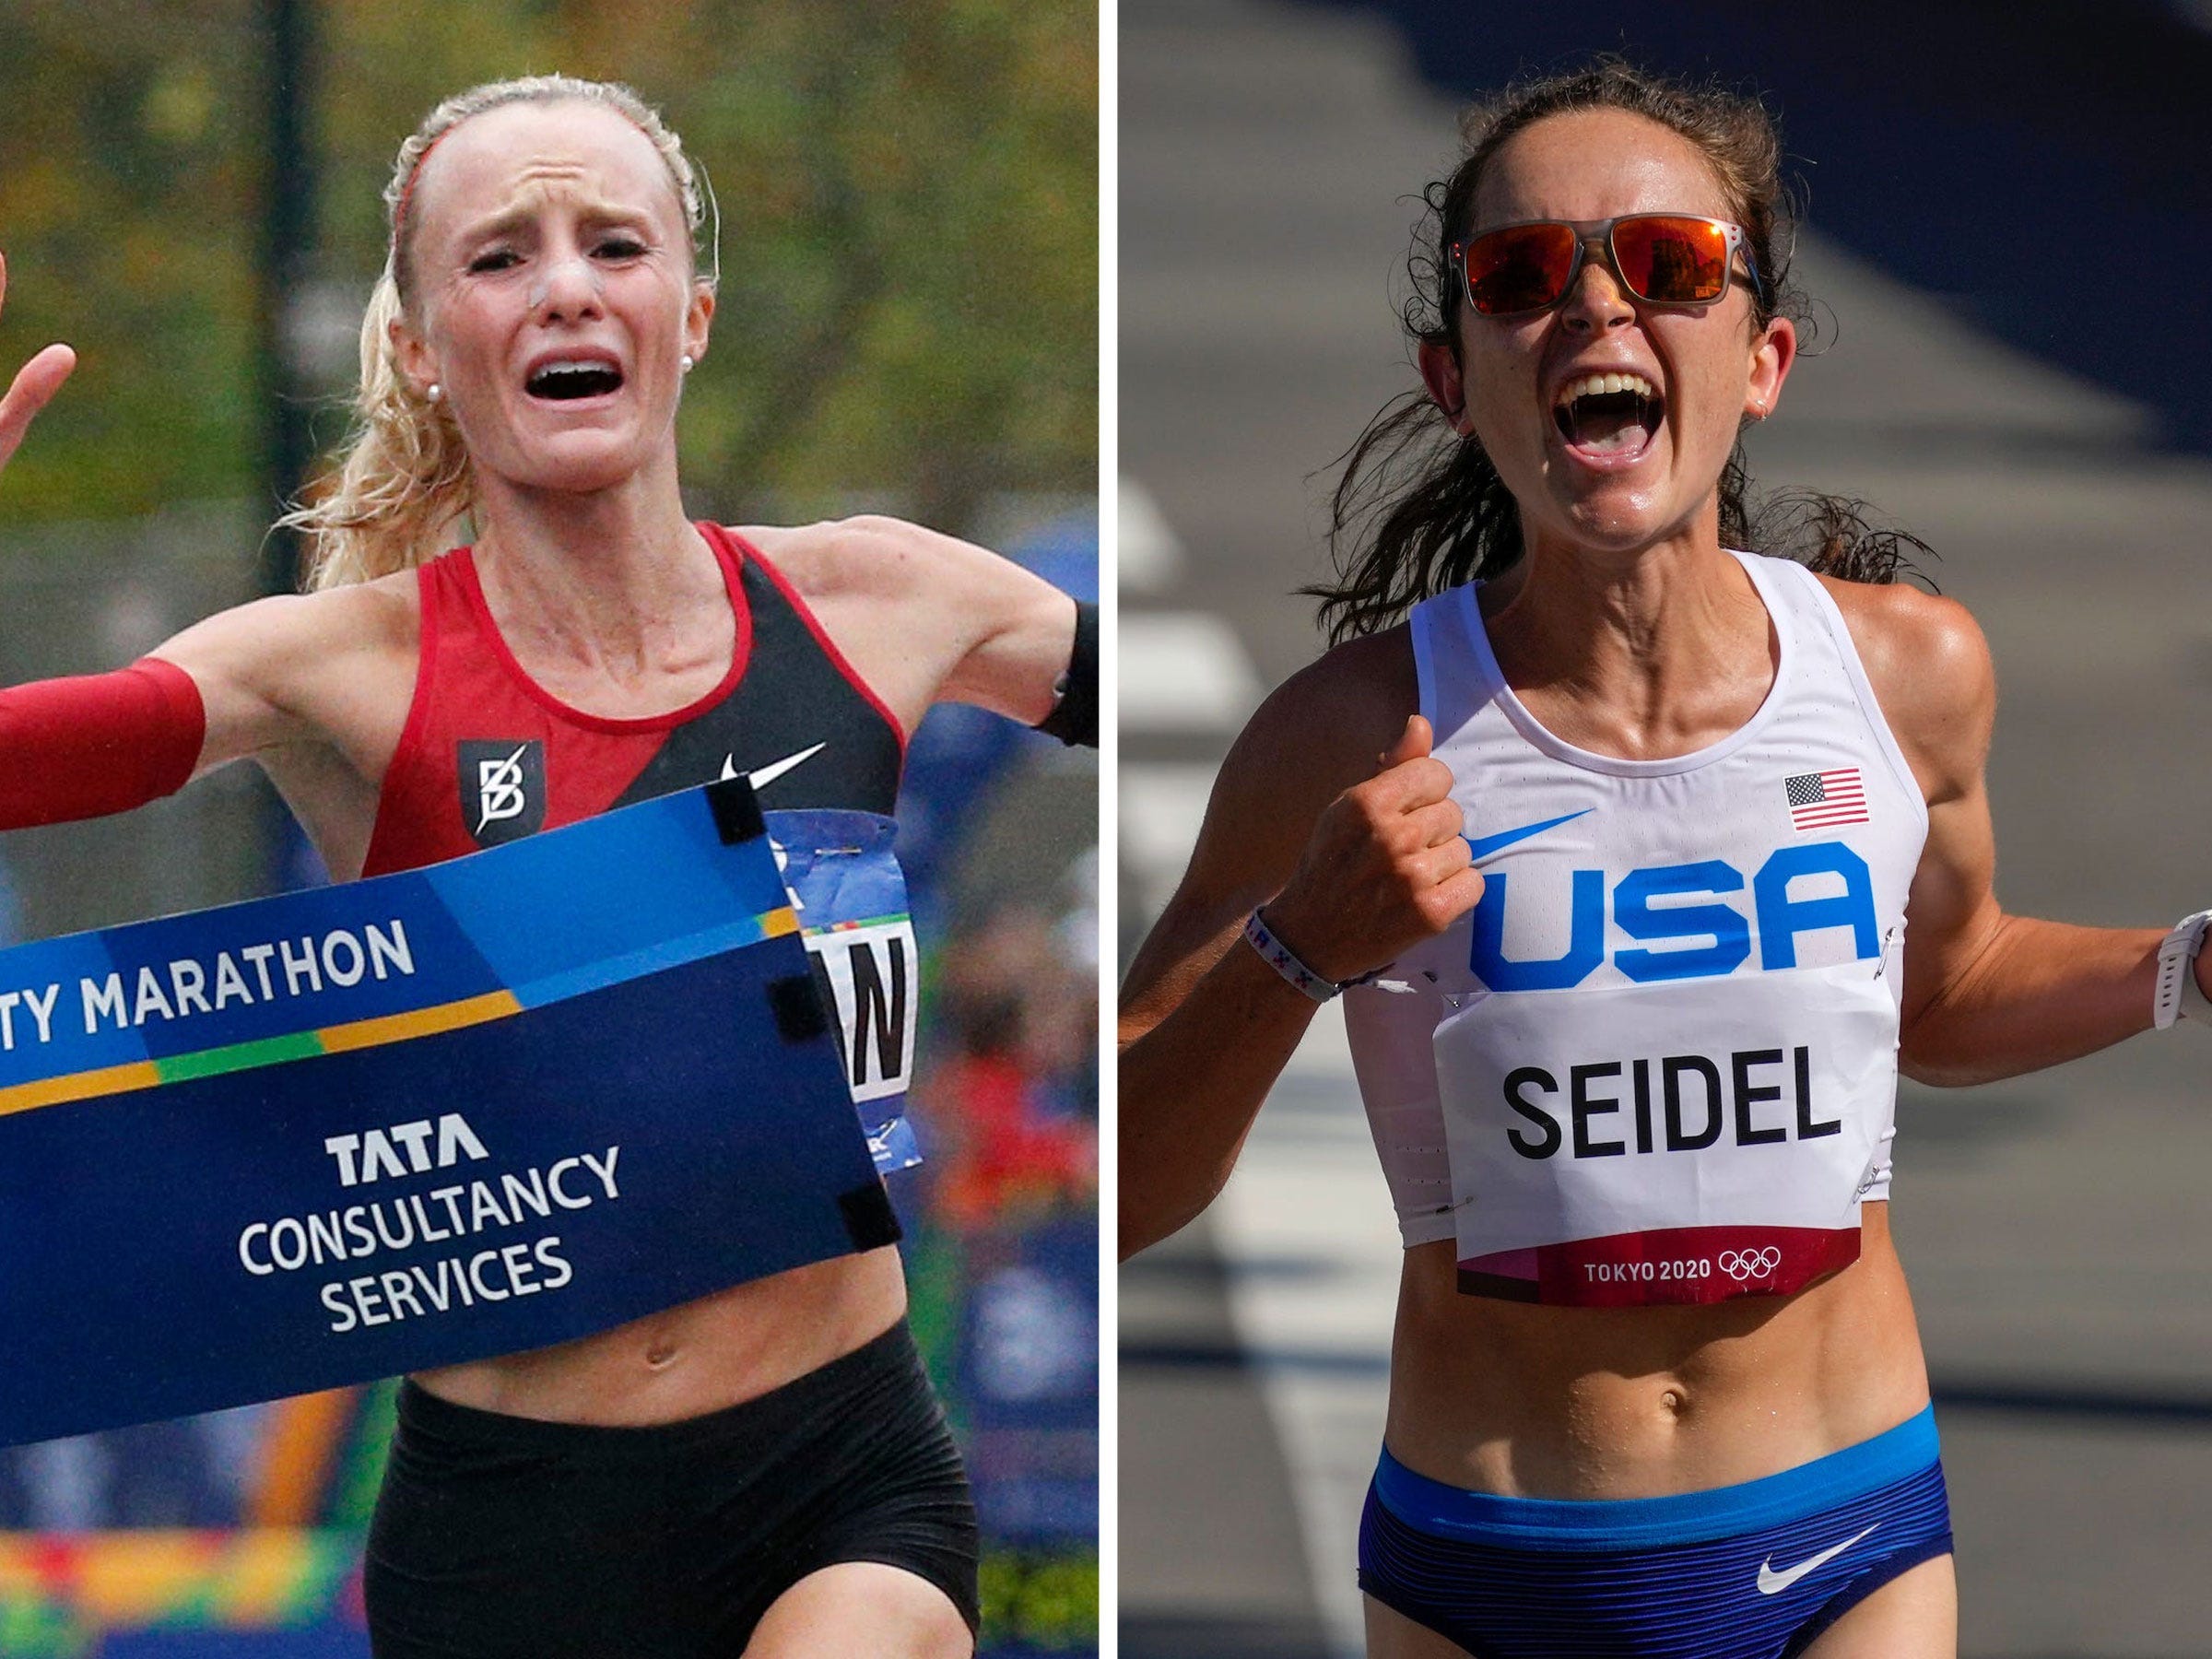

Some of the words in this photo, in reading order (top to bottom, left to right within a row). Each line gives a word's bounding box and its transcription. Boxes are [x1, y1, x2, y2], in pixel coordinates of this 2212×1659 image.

[1469, 841, 1880, 993] USA
[0, 982, 60, 1051] TY
[80, 919, 415, 1034] MARATHON
[324, 1112, 489, 1186] TATA
[1502, 1045, 1841, 1160] SEIDEL
[239, 1146, 620, 1275] CONSULTANCY
[321, 1236, 573, 1333] SERVICES
[1584, 1262, 1654, 1282] TOKYO
[1659, 1258, 1711, 1280] 2020
